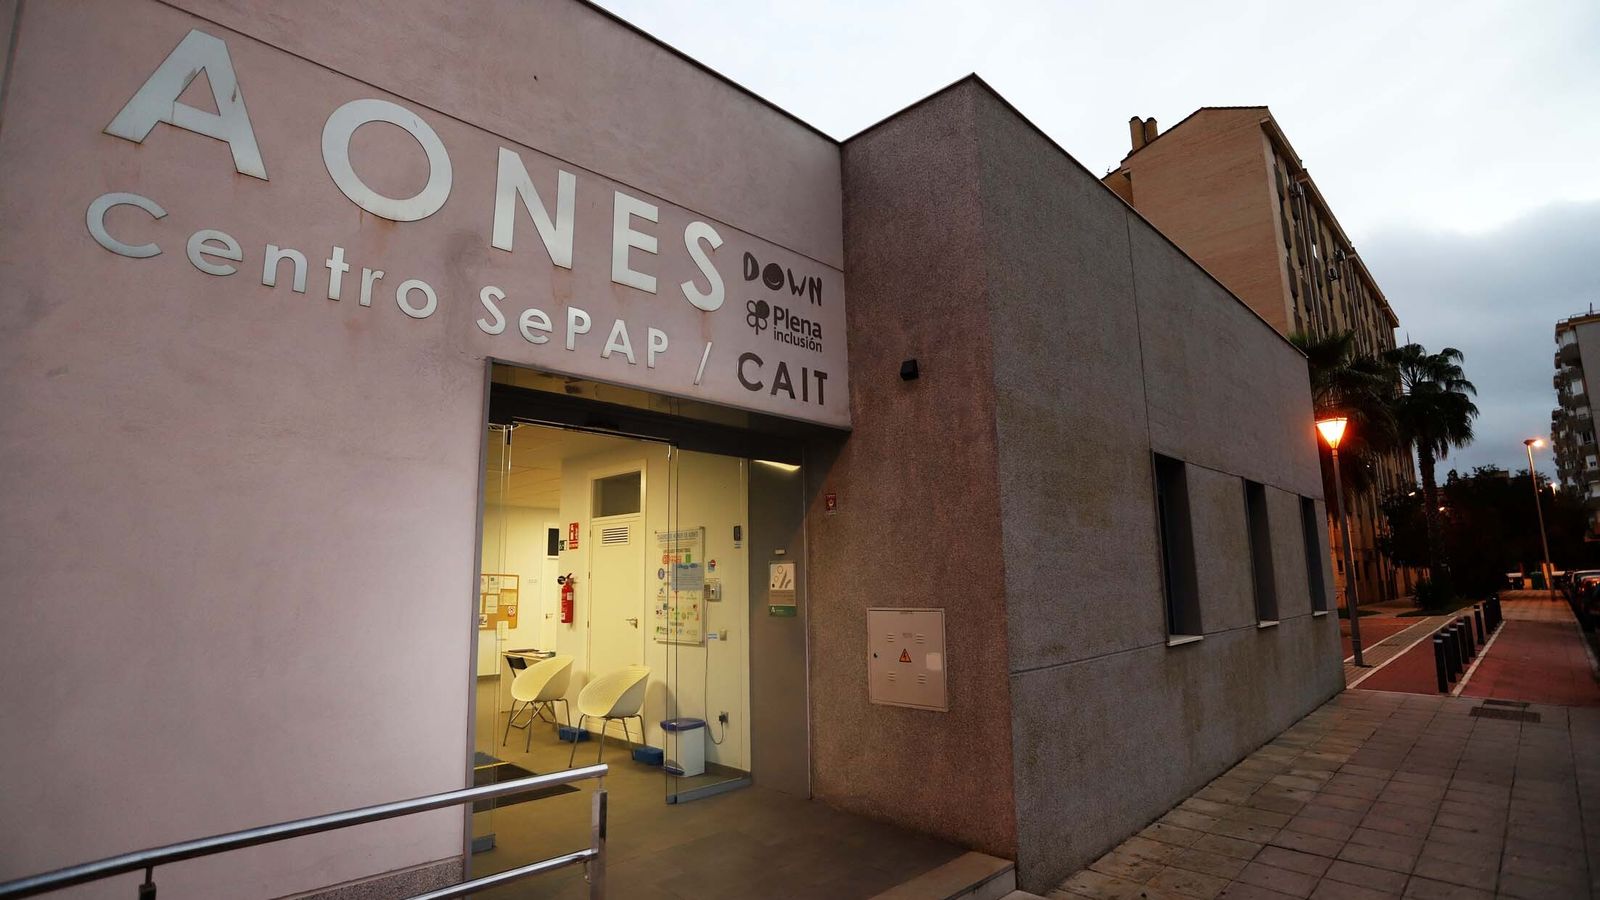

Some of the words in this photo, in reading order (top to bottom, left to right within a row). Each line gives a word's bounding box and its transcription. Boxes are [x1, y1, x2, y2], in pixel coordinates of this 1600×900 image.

[102, 28, 725, 312] AONES
[86, 191, 438, 319] Centro
[476, 285, 669, 369] SePAP
[736, 352, 828, 405] CAIT
[743, 251, 823, 306] DOWN
[773, 305, 823, 340] Plena
[773, 327, 823, 353] inclusión
